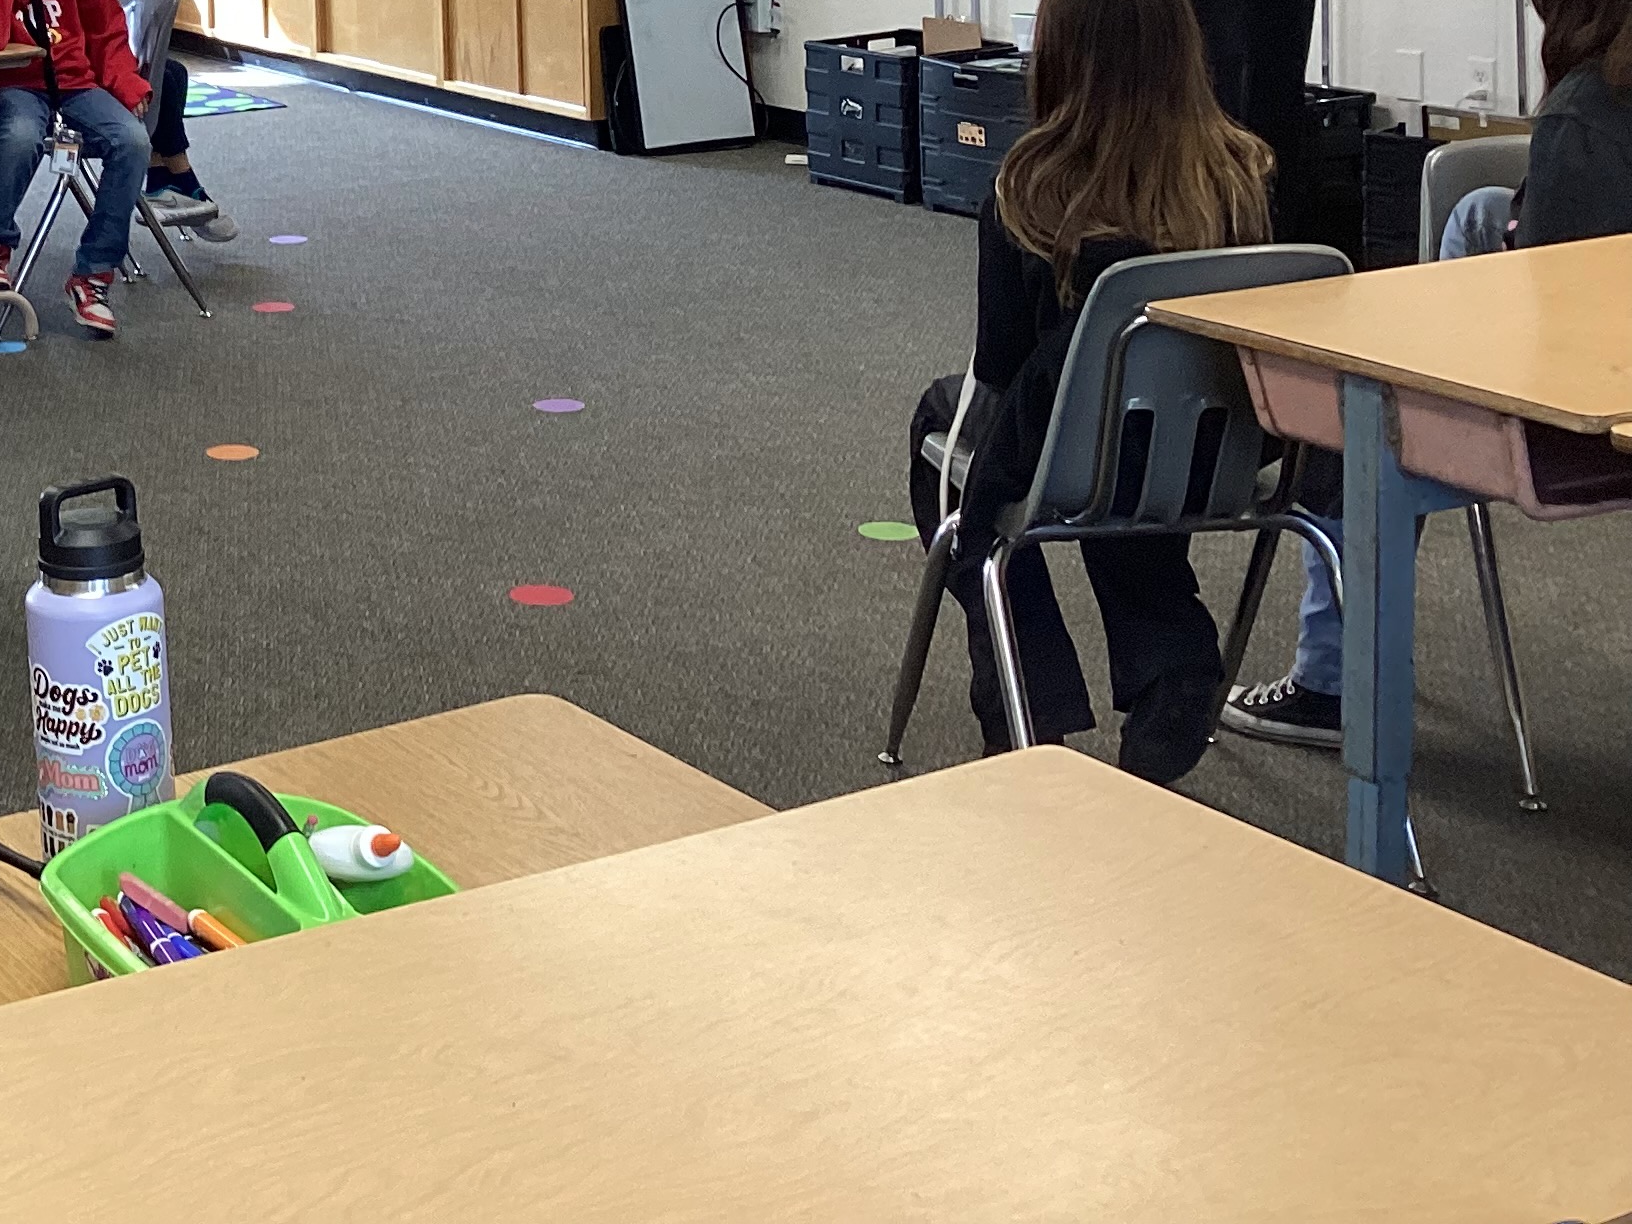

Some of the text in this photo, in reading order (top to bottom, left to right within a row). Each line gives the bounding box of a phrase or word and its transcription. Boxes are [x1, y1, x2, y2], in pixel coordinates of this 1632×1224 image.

[101, 619, 135, 648] JUST
[128, 637, 141, 649] TO
[118, 645, 151, 676] PET
[33, 667, 99, 716] Dogs
[107, 662, 161, 696] ALL THE
[113, 683, 160, 718] DOGS
[37, 706, 102, 744] Happy
[40, 757, 100, 792] Mom
[124, 754, 159, 778] mom
